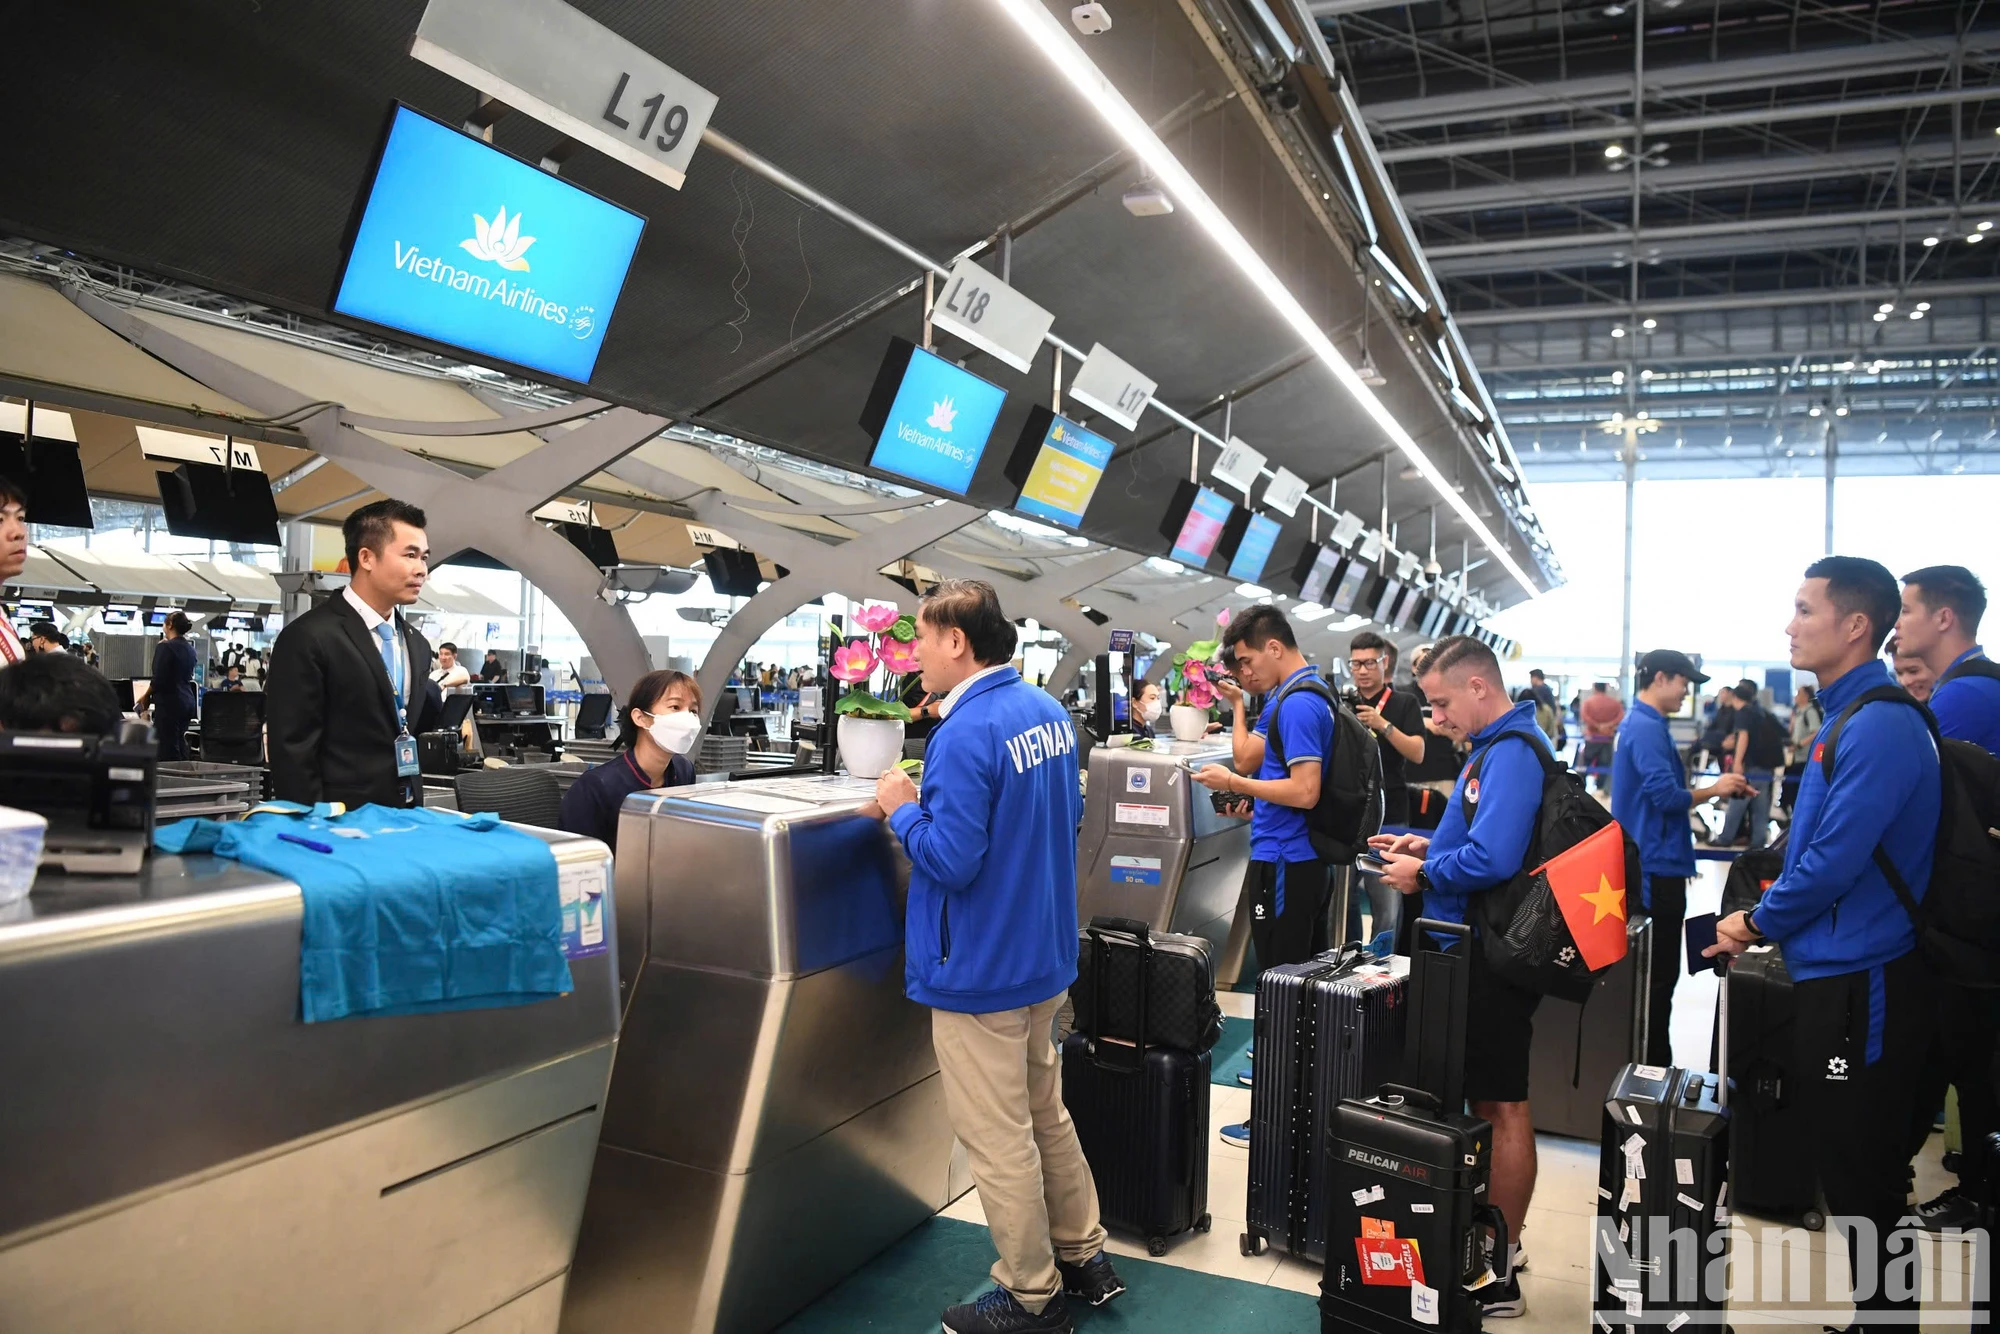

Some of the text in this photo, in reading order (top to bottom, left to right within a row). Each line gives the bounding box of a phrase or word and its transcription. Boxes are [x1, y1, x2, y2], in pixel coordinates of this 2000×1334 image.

[603, 72, 689, 152] L19
[946, 277, 990, 323] L18
[1117, 382, 1147, 414] L17
[1348, 1149, 1427, 1179] PELICAN AIR
[1401, 1243, 1415, 1280] FRAGILE
